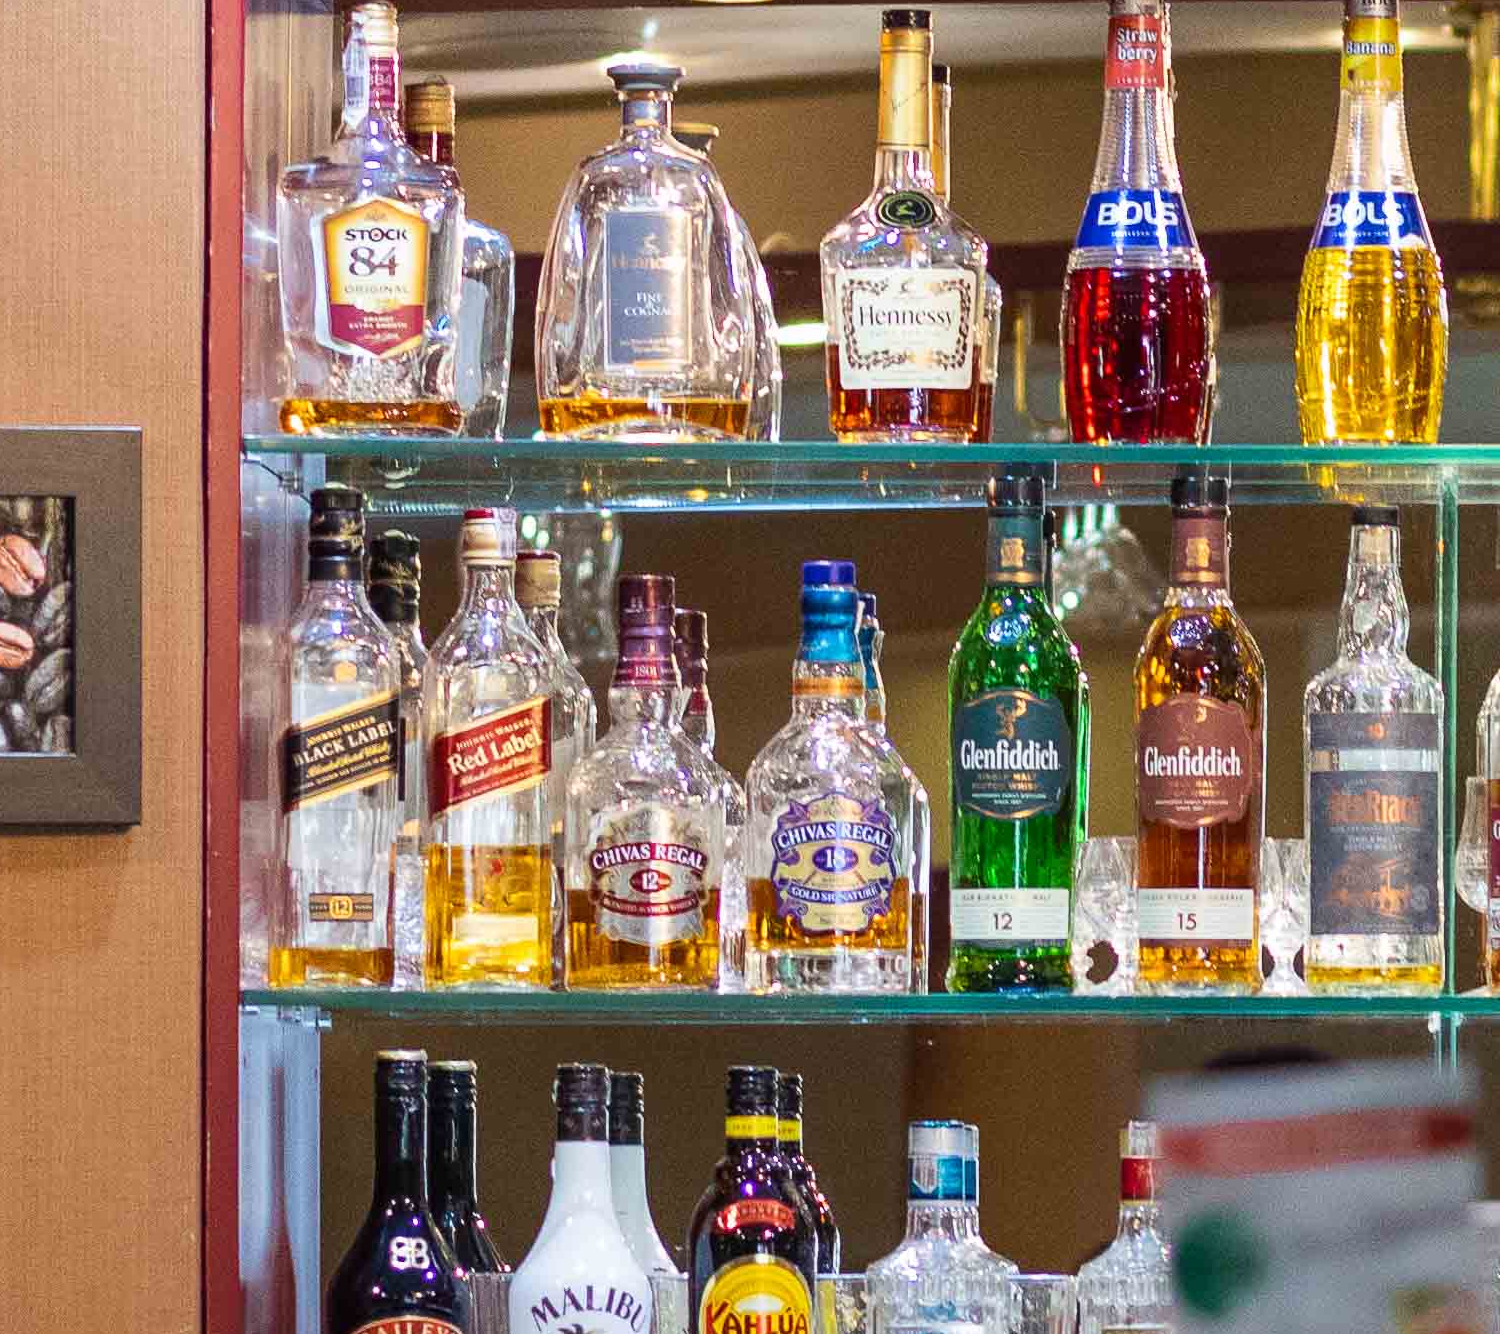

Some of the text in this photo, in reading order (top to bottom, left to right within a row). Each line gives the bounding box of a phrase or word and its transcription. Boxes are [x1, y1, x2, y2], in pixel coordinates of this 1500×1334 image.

[1115, 27, 1157, 44] Straw
[1116, 44, 1157, 64] berry
[1098, 200, 1180, 227] BOLS
[1323, 201, 1405, 227] BOLS
[344, 227, 408, 243] STOCK
[348, 246, 400, 277] 84
[857, 304, 956, 328] Hennessy
[293, 739, 346, 767] BLACK
[347, 720, 397, 748] LABEL
[446, 745, 489, 776] Red
[489, 726, 543, 760] Label
[960, 738, 1060, 771] Glenfiddich
[1143, 745, 1242, 778] Glenfiddich
[777, 822, 889, 849] CHIVAS REGAL
[592, 843, 704, 871] CHIVAS REGAL
[641, 870, 659, 891] 12
[791, 885, 820, 901] GOLD
[333, 897, 351, 916] 12
[992, 913, 1013, 931] 12
[1176, 913, 1198, 931] 15
[531, 1284, 647, 1334] MALIBU
